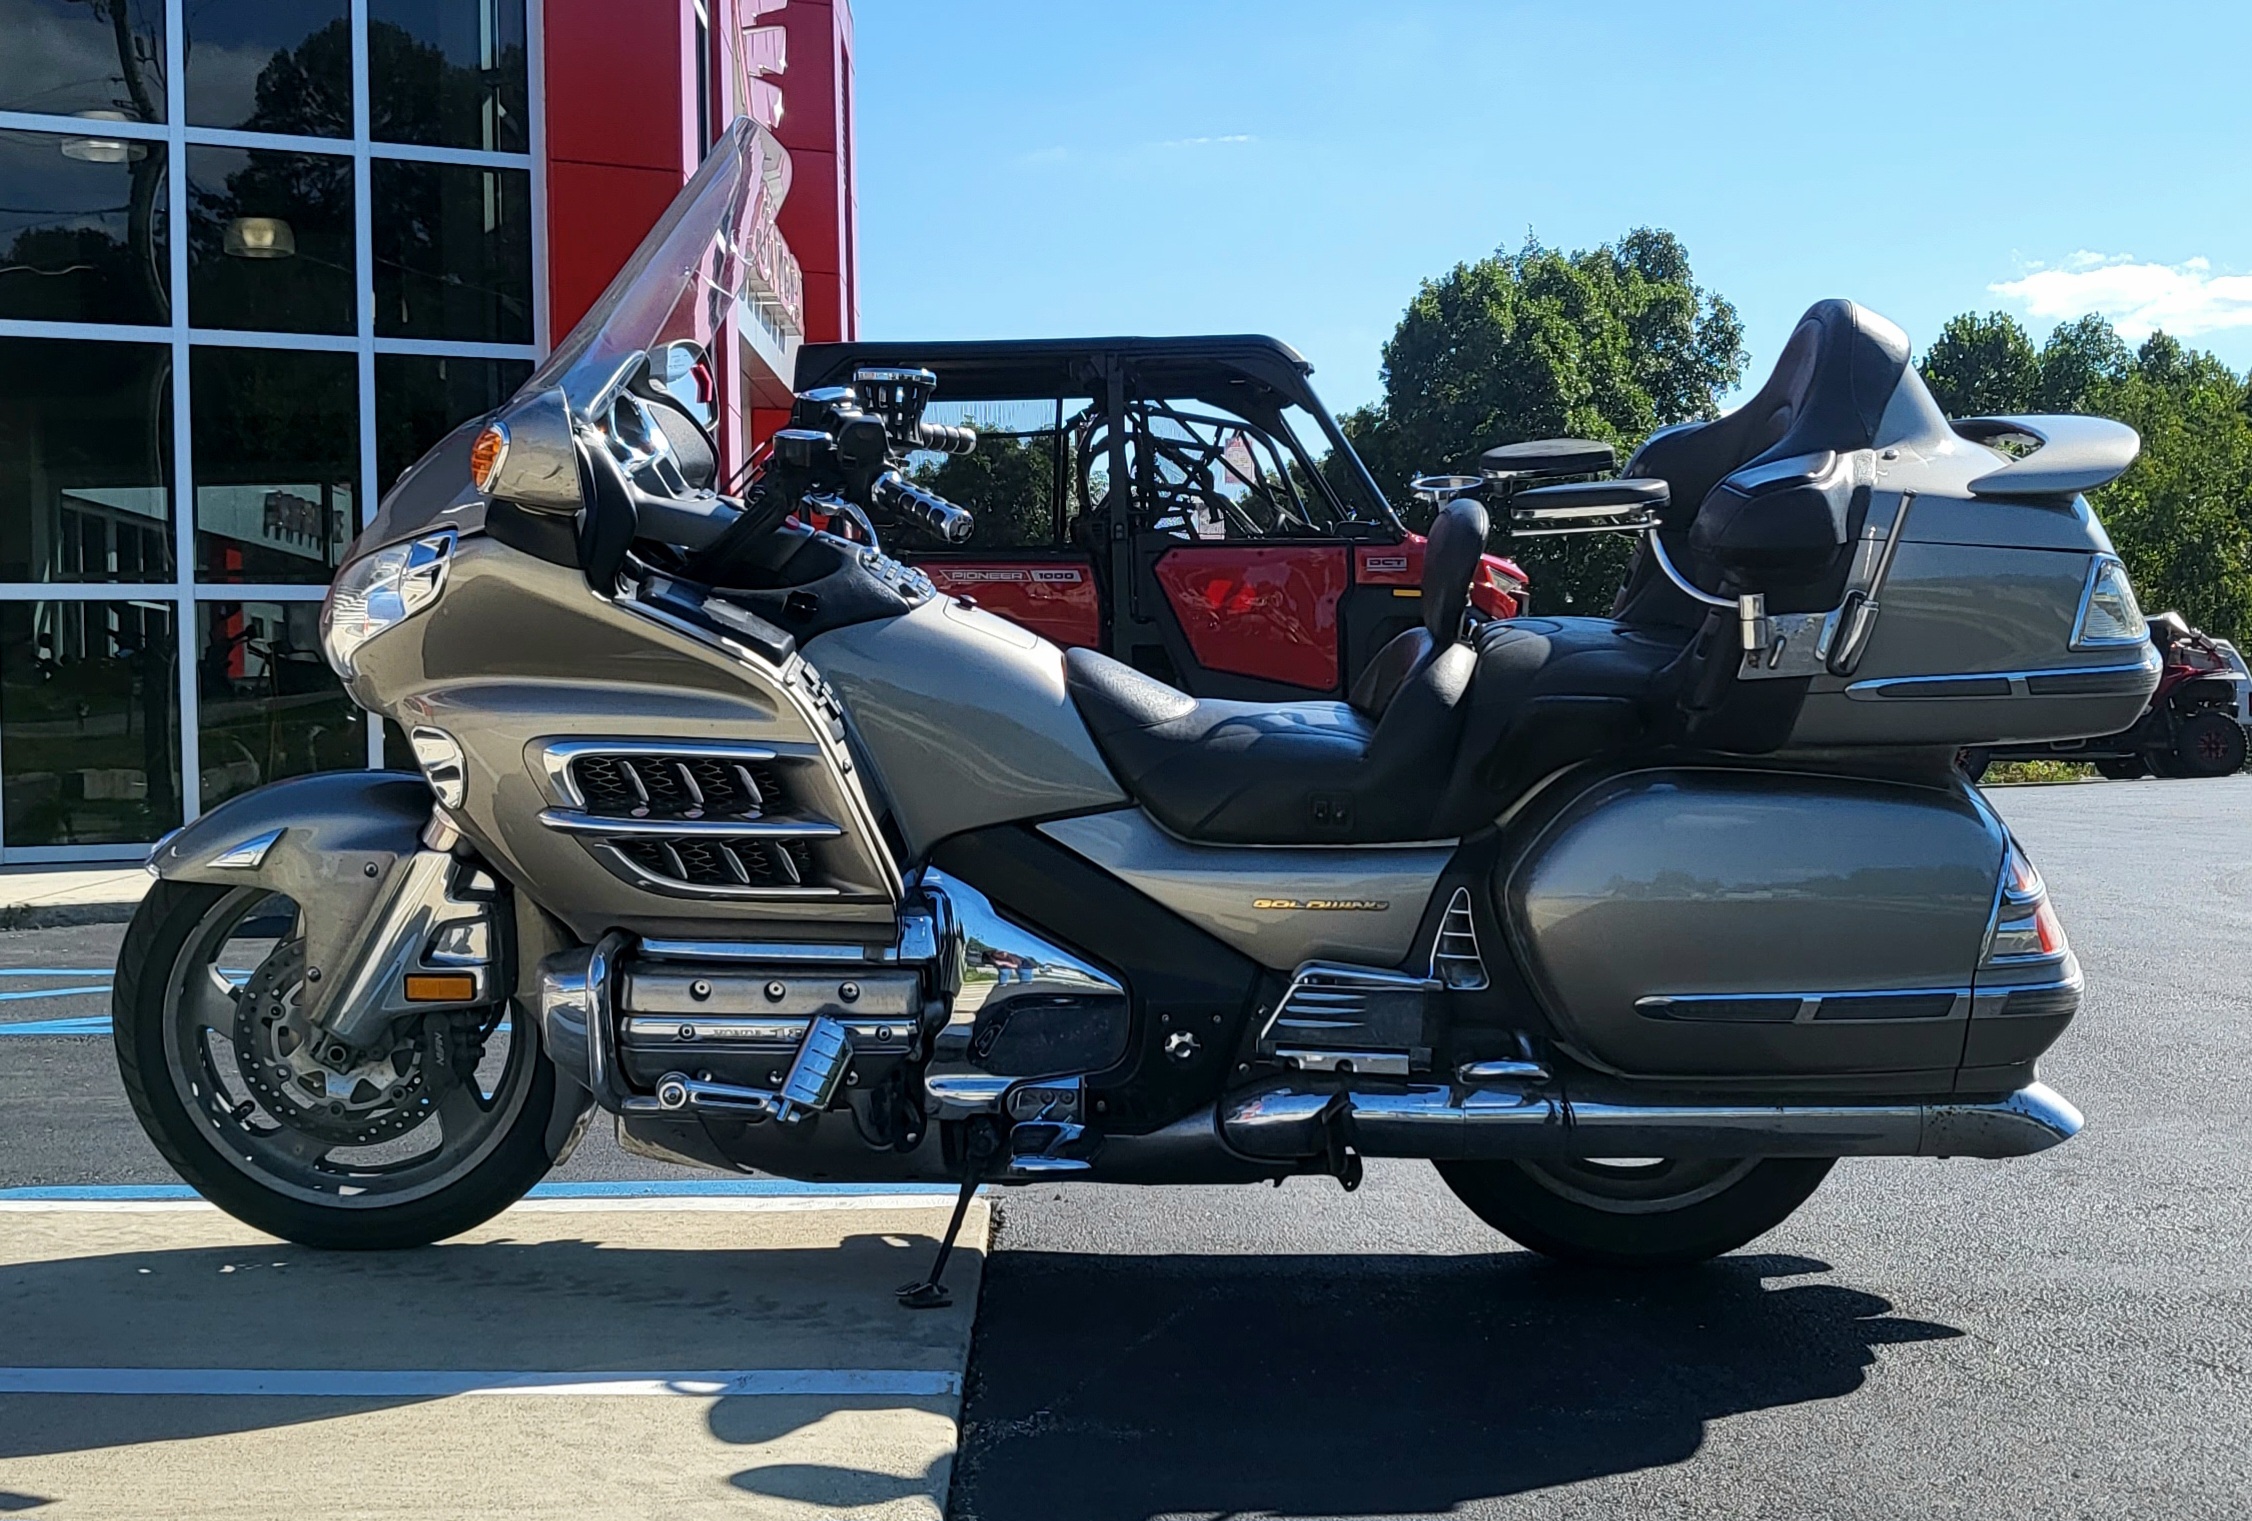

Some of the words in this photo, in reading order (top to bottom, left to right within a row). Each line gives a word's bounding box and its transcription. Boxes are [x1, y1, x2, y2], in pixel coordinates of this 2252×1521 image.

[1369, 559, 1405, 567] DCT
[951, 571, 1023, 580] PIONEER
[1038, 572, 1075, 580] 1000
